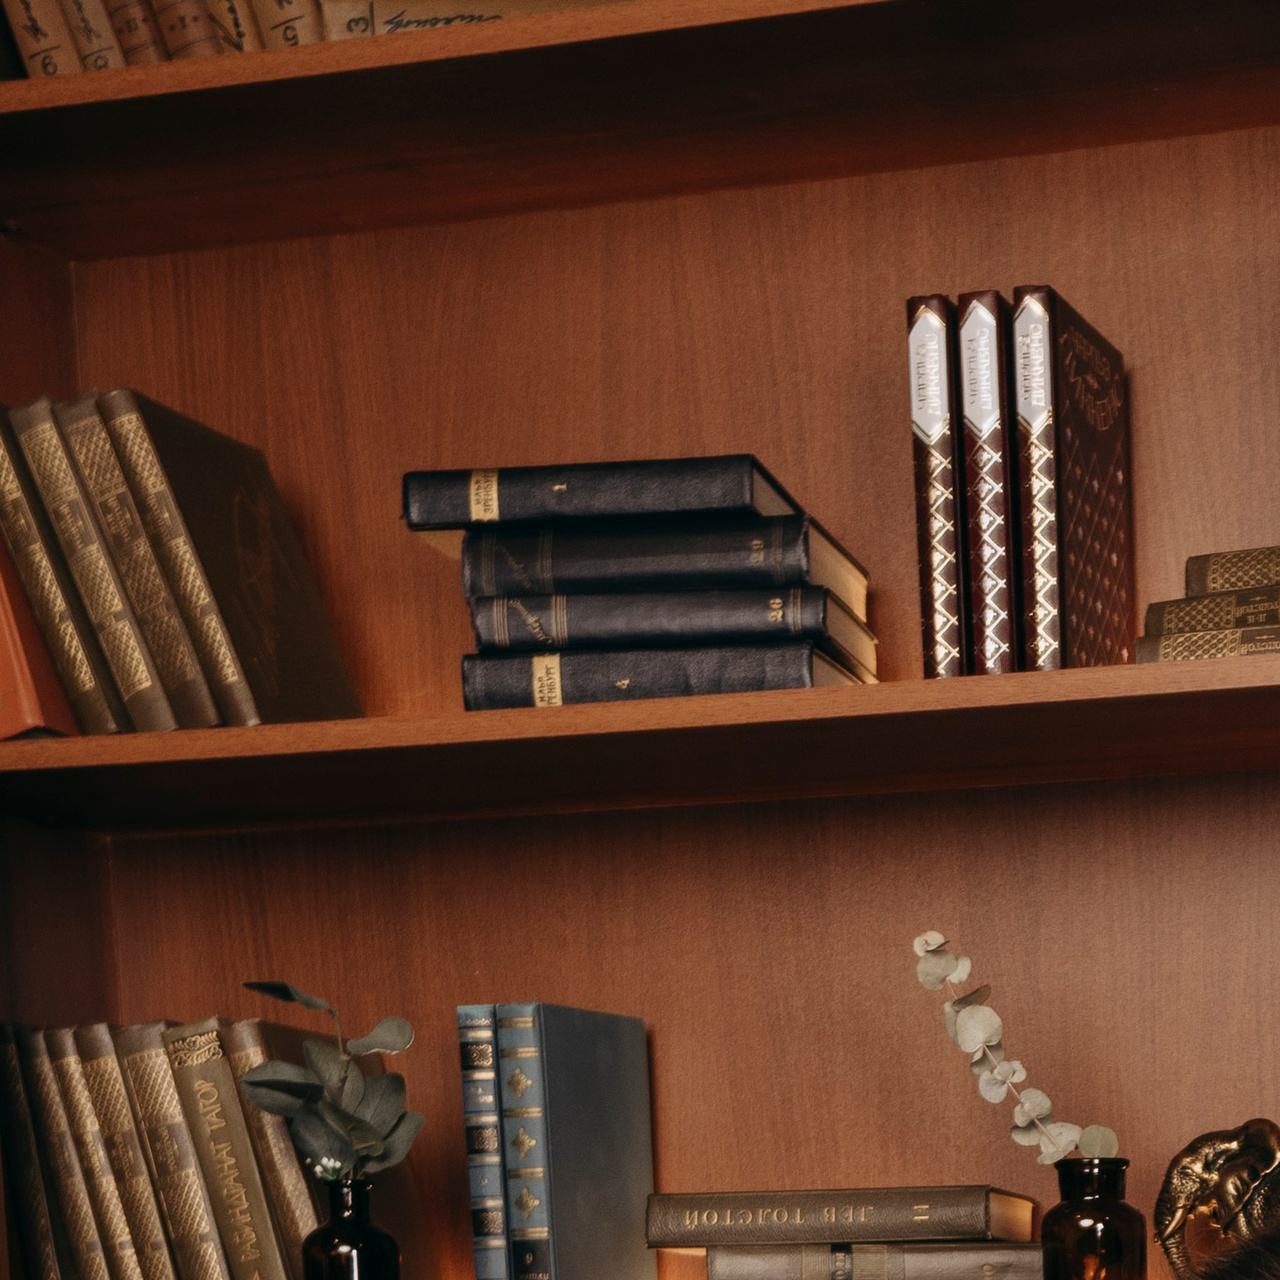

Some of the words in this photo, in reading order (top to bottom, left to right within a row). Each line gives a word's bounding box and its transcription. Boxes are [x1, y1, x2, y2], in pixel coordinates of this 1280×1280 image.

[545, 664, 556, 706] РЕНБУРГ
[194, 1079, 227, 1135] ТАГОР
[683, 1207, 805, 1230] ТОЛСТОЙ
[823, 1205, 874, 1223] ЛЕВ
